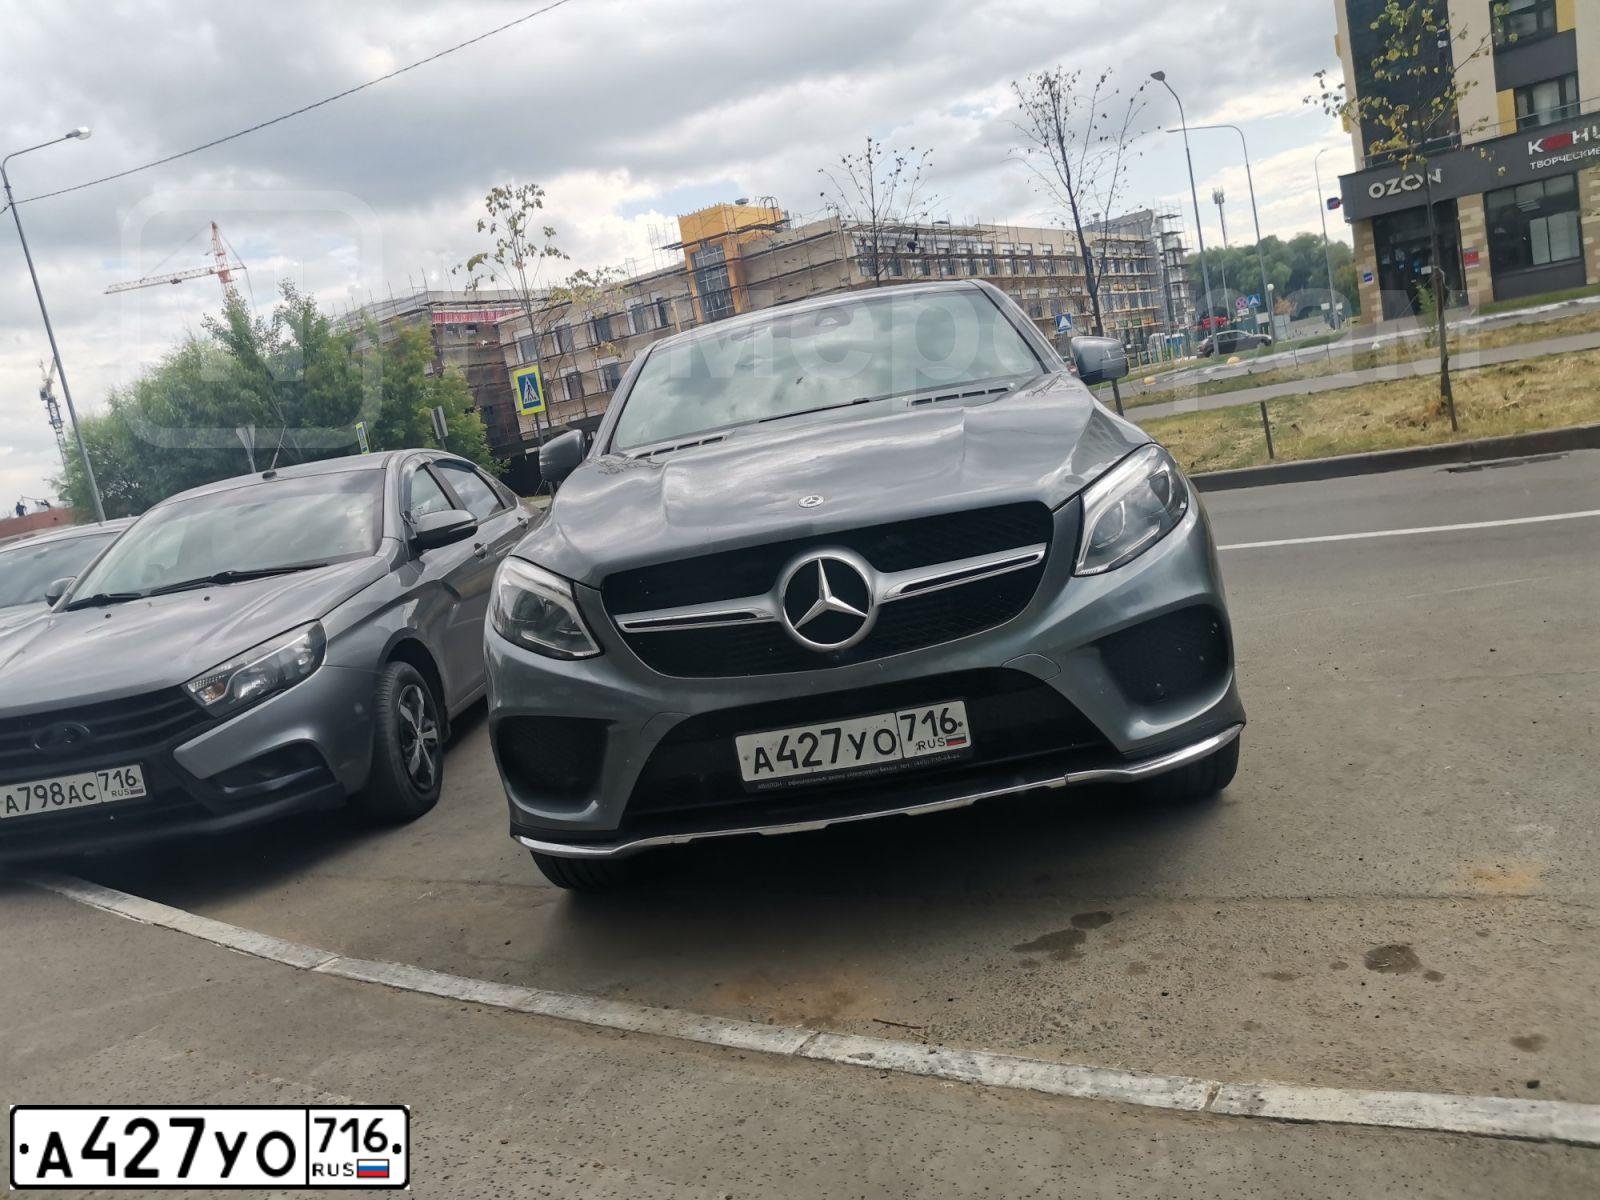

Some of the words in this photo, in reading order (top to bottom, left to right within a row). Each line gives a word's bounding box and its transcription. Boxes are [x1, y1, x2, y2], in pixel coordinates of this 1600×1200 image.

[1368, 168, 1442, 199] OZON
[900, 707, 958, 742] 716
[917, 737, 946, 751] RUS
[98, 768, 137, 791] 716
[111, 789, 130, 798] RUS
